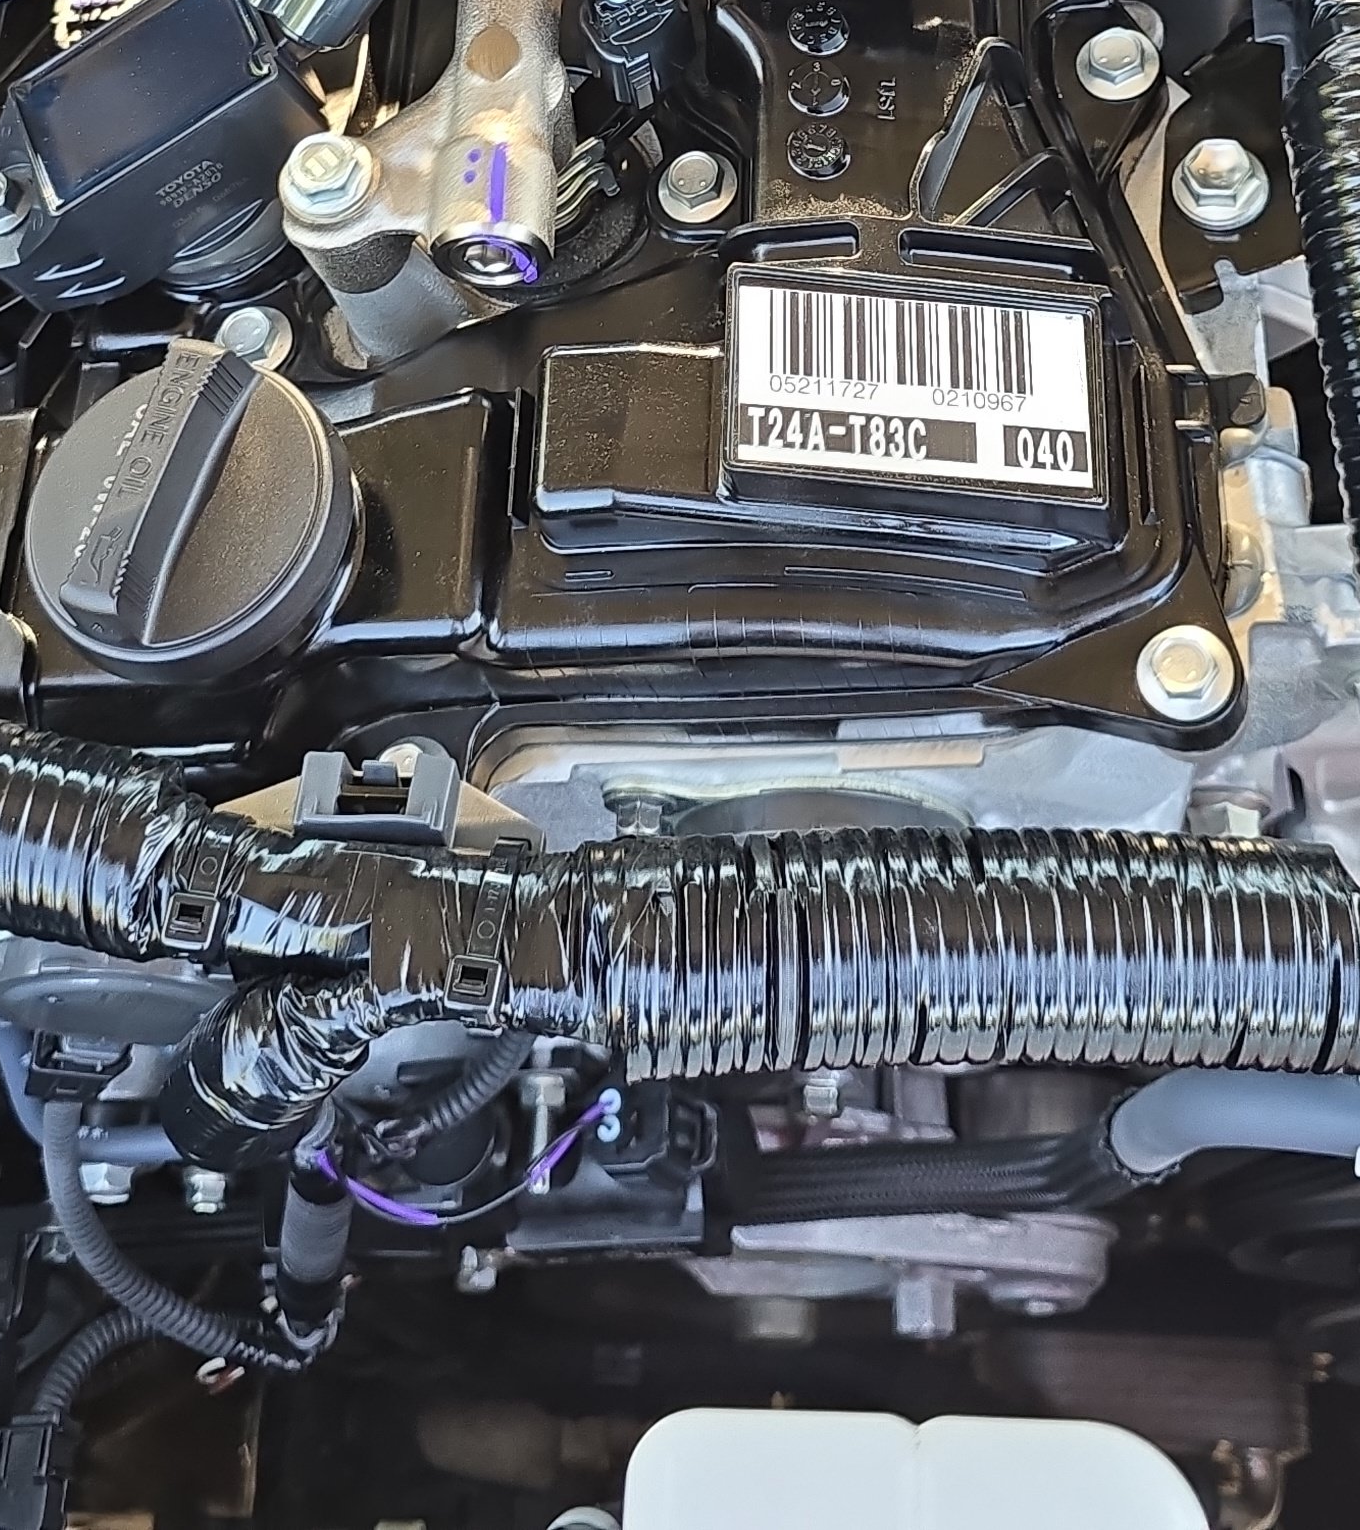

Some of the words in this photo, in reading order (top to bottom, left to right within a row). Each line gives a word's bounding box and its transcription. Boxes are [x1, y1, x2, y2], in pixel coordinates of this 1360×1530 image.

[155, 160, 214, 196] TOYOTA
[173, 172, 222, 209] DENSO
[149, 352, 204, 447] ENGINE
[769, 374, 880, 401] 05211727
[932, 387, 1028, 413] 0210967
[746, 405, 928, 462] T24A-T83C
[1016, 429, 1074, 472] 040
[118, 455, 155, 499] OIL
